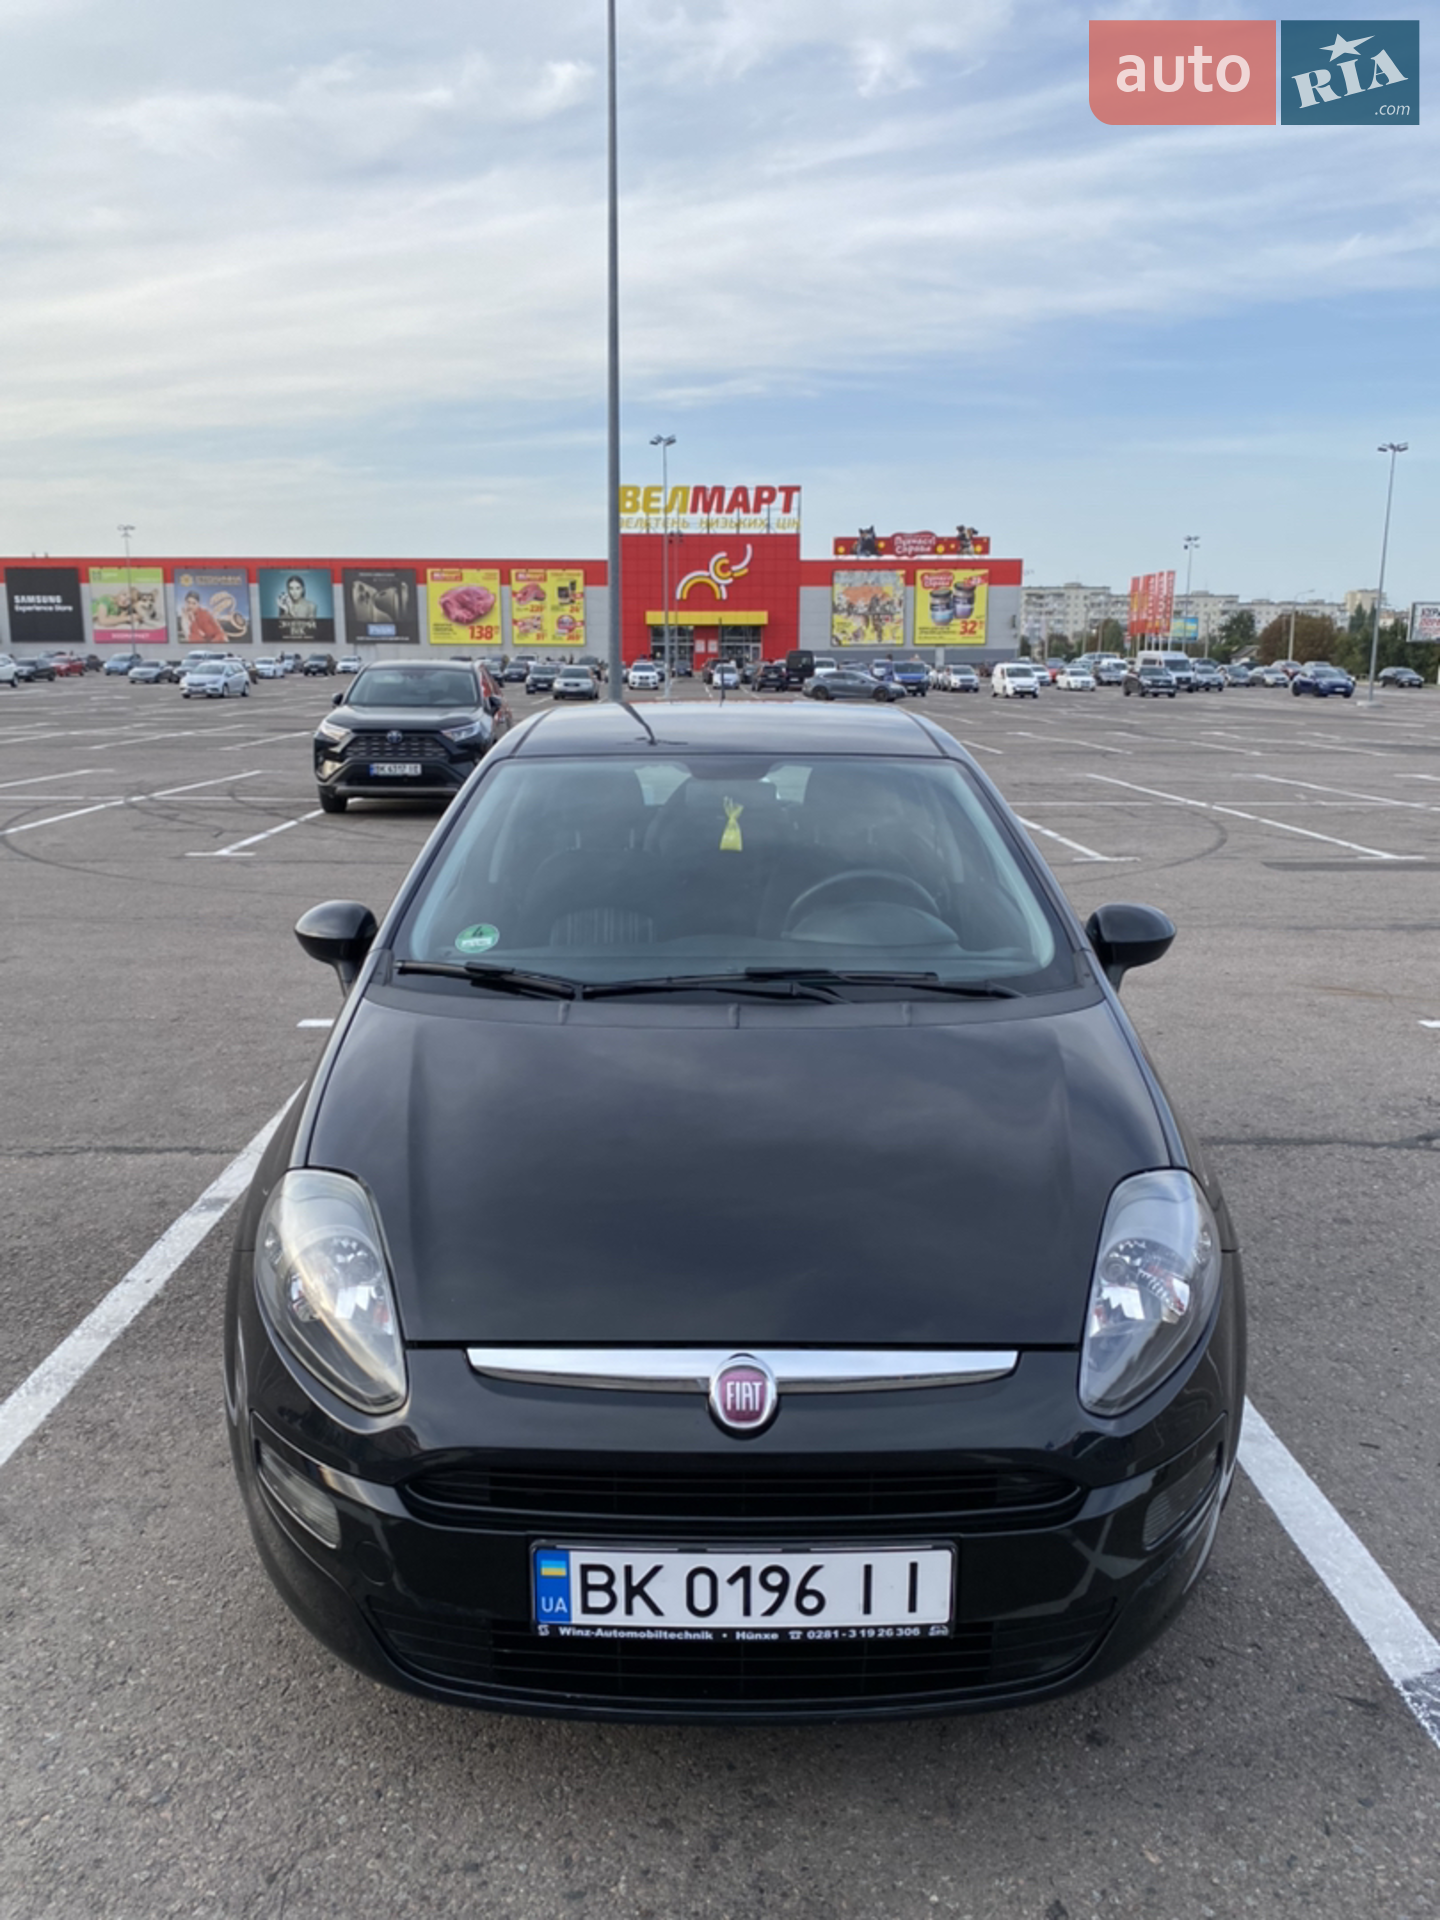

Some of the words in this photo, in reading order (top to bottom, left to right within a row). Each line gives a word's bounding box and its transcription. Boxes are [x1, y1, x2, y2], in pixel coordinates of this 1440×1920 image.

[618, 485, 801, 515] ВЕЛМАРТ
[13, 595, 63, 604] SAMSUNG
[469, 625, 494, 640] 138
[960, 620, 978, 635] 32
[726, 1381, 762, 1411] FIAT
[579, 1563, 665, 1617] BK
[685, 1565, 826, 1618] 0196
[541, 1597, 568, 1614] UA
[558, 1626, 714, 1641] Winz-Automobiltechnik
[735, 1630, 780, 1641] Hünxe
